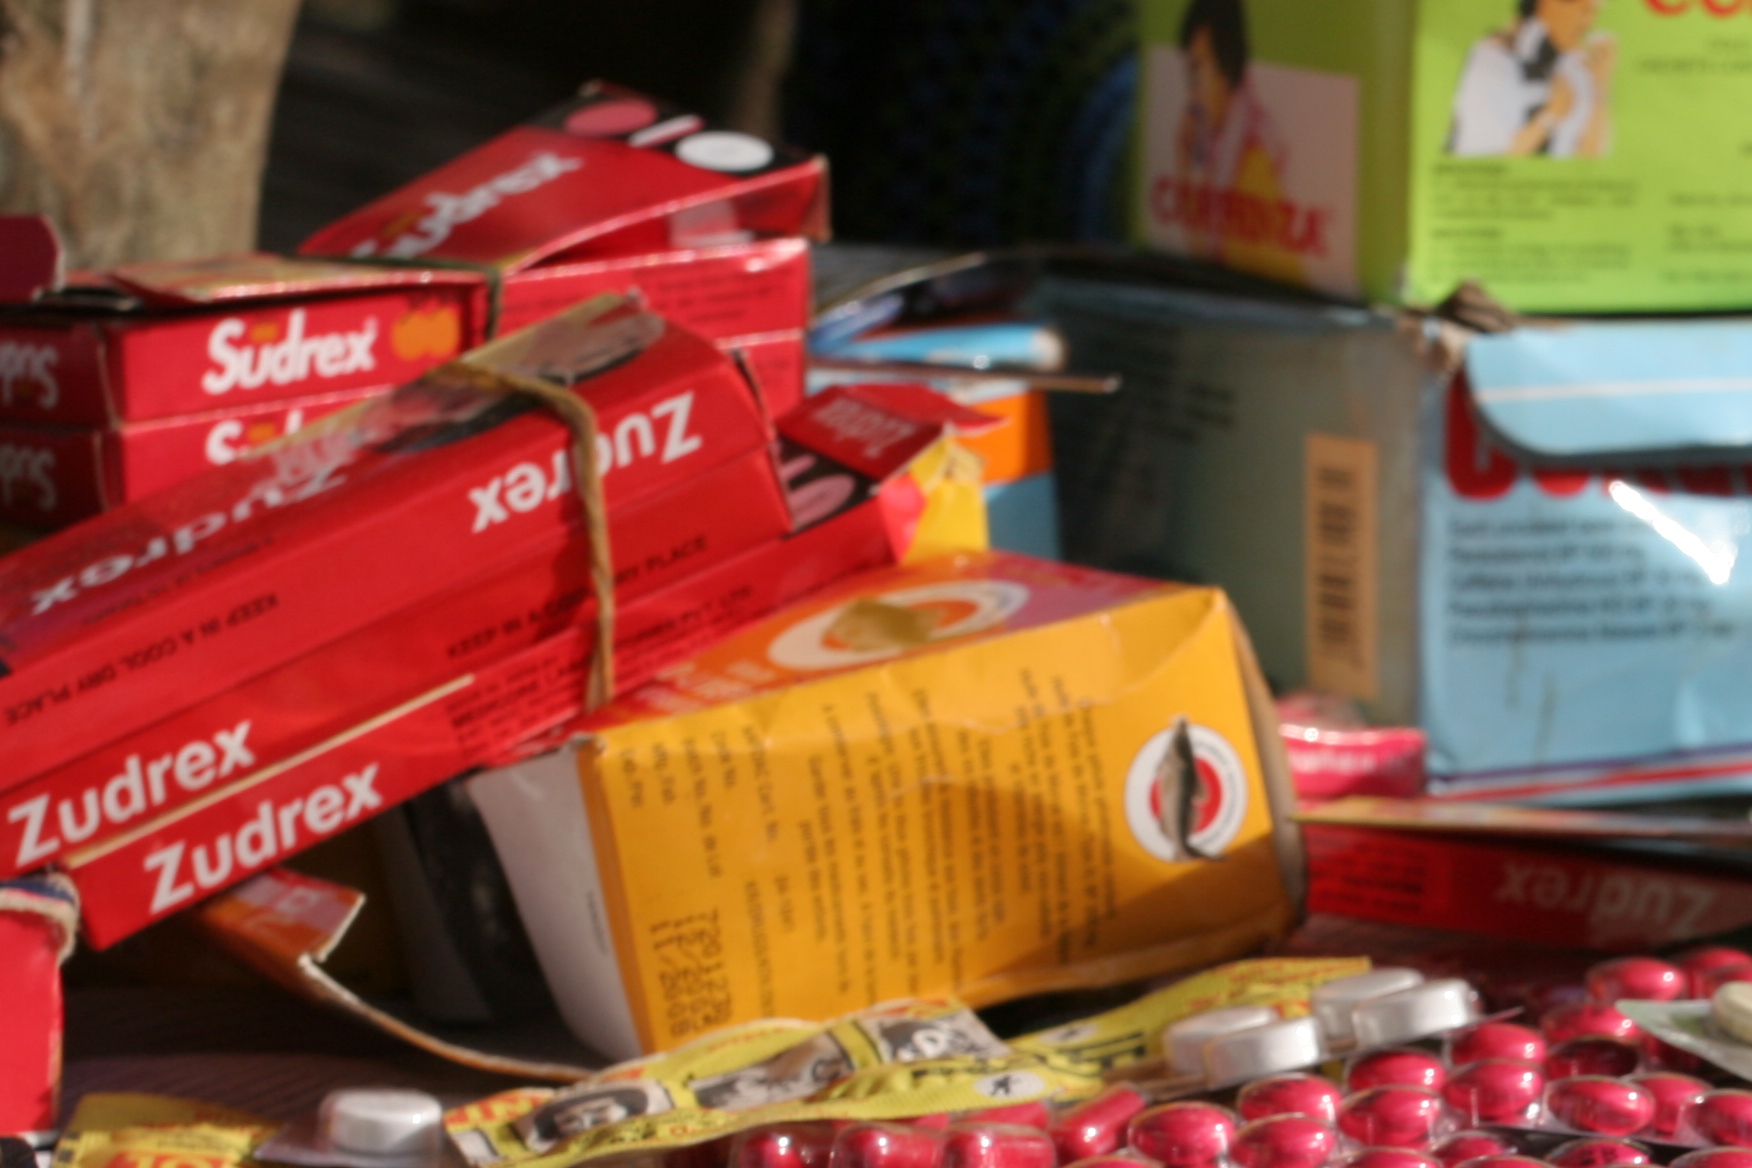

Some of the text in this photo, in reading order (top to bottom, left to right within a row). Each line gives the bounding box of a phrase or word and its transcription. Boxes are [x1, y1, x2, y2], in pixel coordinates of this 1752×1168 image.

[202, 307, 378, 396] Sudrex
[200, 615, 221, 637] IN
[226, 591, 279, 627] KEEP
[119, 637, 179, 673] COOL
[179, 628, 195, 646] A
[8, 720, 255, 866] Zudrex
[143, 762, 384, 915] Zudrex
